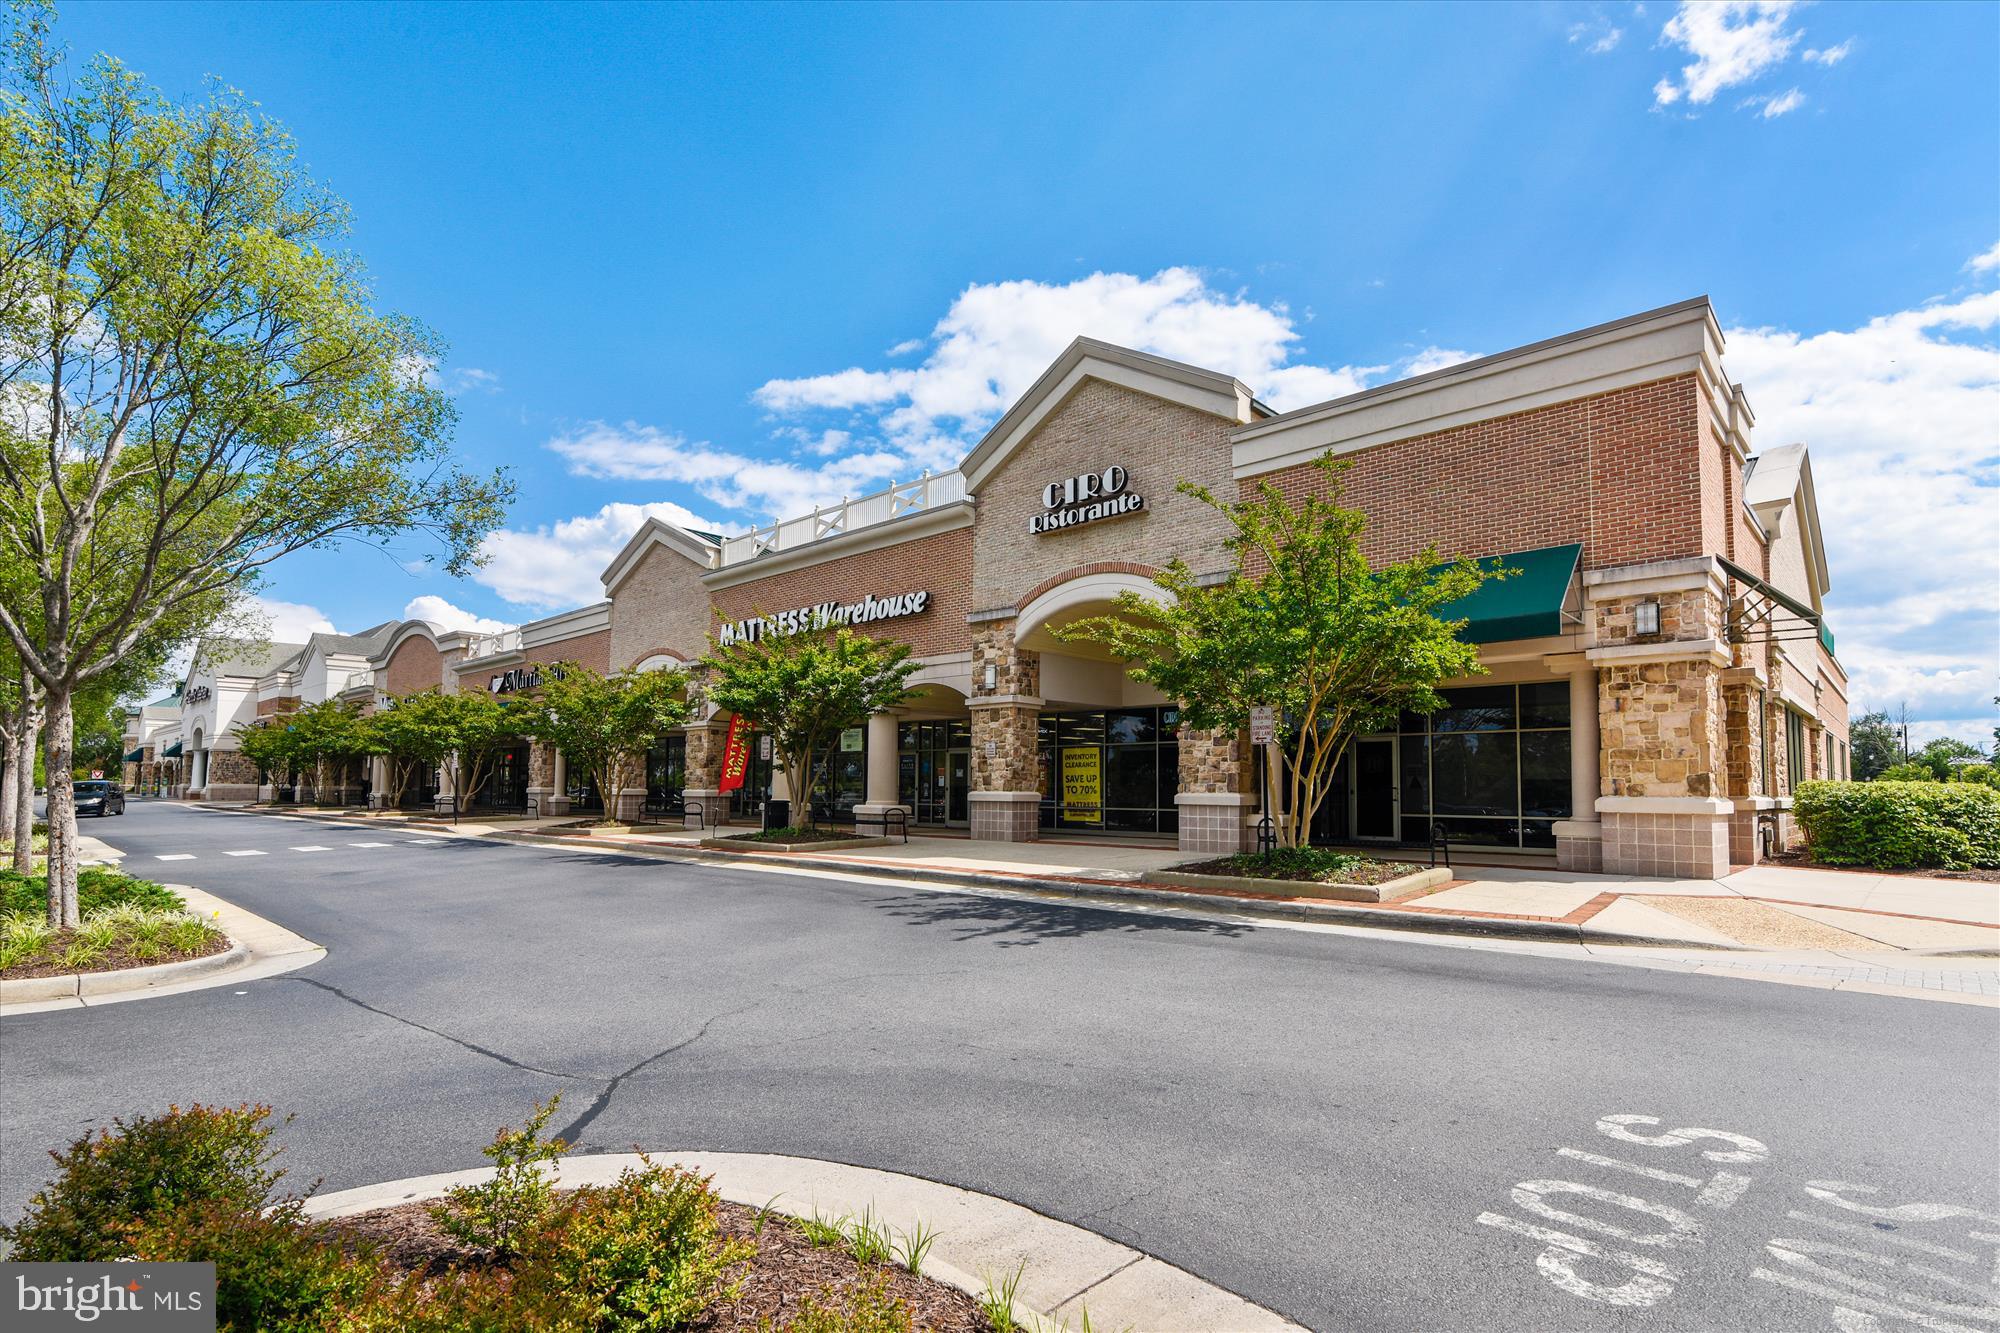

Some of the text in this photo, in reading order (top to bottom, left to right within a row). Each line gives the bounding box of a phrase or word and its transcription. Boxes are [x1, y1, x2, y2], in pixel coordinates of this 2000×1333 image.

[1042, 465, 1129, 510] CIRO
[1029, 493, 1144, 534] Ristorante
[720, 590, 932, 646] MATTRESS Warehouse
[1064, 753, 1097, 761] INVENTORY
[1065, 775, 1097, 783] SAVE UP
[1066, 785, 1097, 794] TO 70%
[1476, 1112, 1771, 1306] STOP
